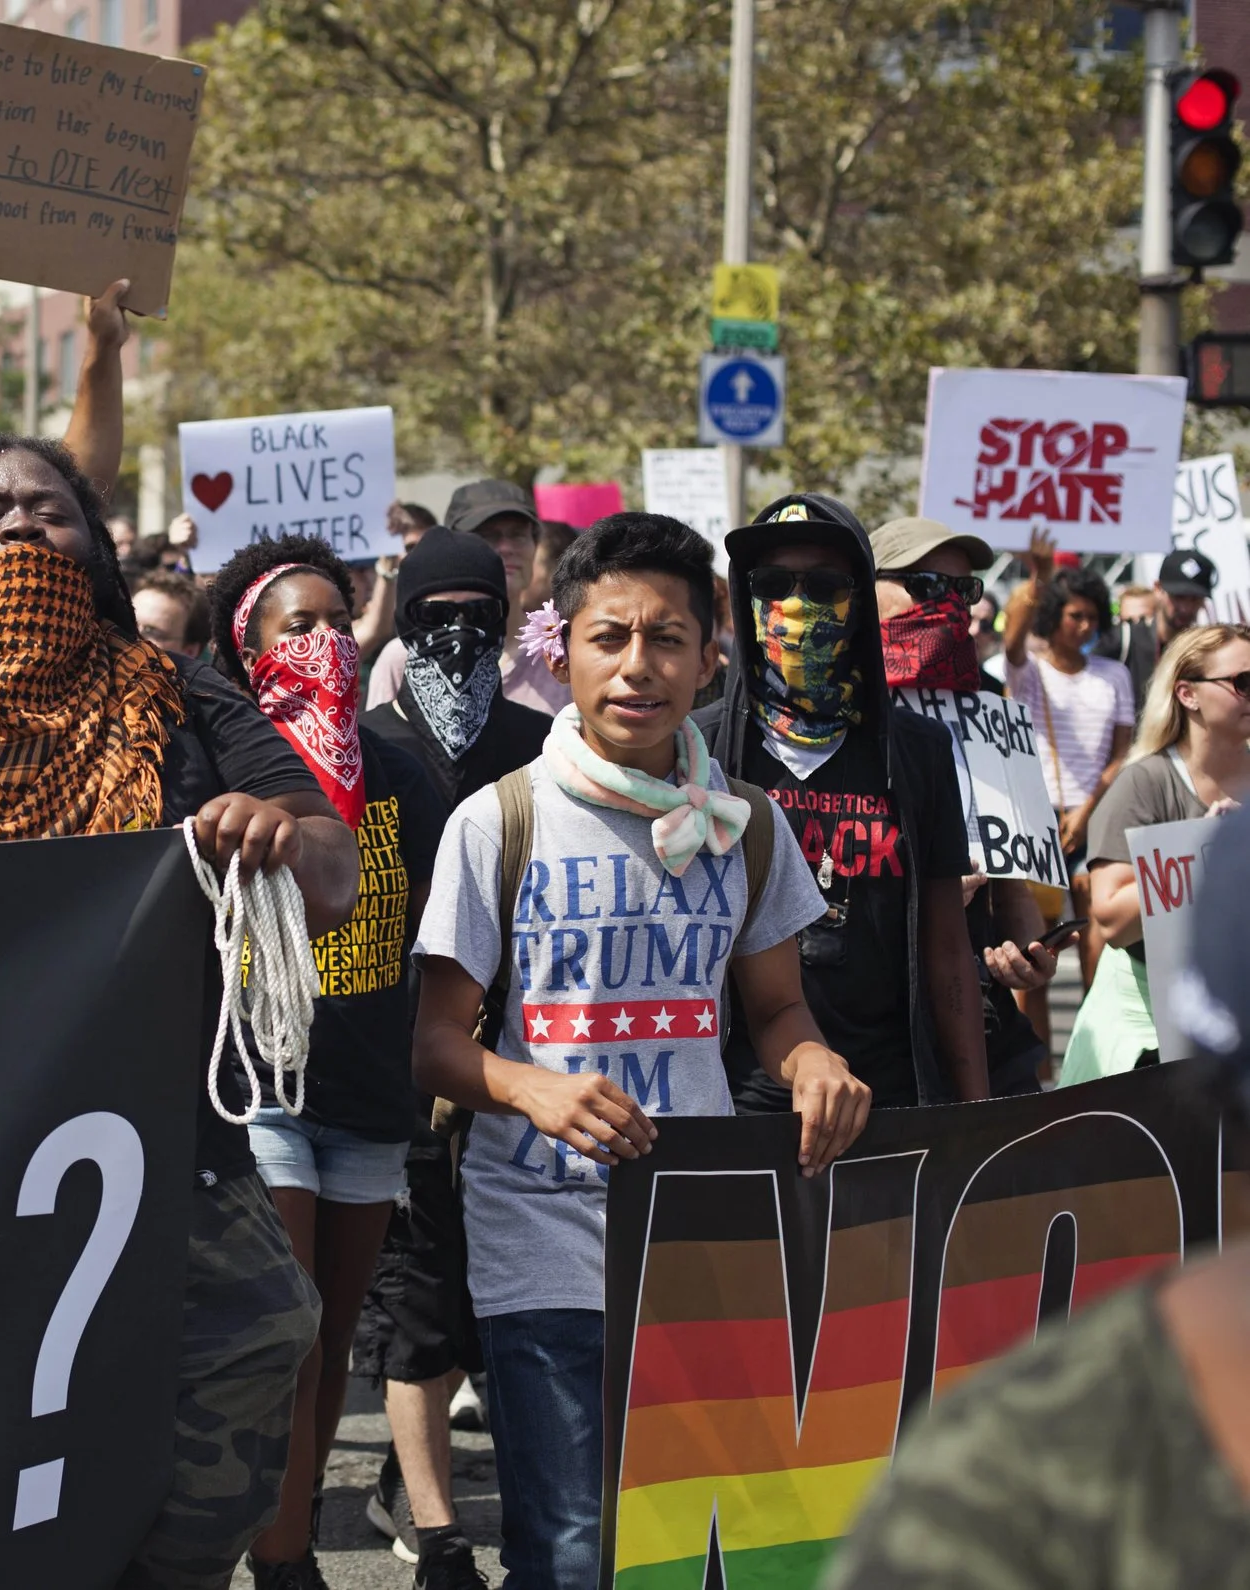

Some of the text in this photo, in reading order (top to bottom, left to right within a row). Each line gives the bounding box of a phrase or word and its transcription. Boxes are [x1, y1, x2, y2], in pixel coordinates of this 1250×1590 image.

[23, 52, 44, 77] to
[51, 52, 92, 86] bite
[56, 109, 92, 137] Has
[105, 122, 166, 161] begun
[7, 144, 38, 181] to
[50, 148, 101, 189] DIE
[109, 165, 179, 209] Next
[251, 423, 329, 454] BLACK
[977, 416, 1129, 469] STOP
[246, 452, 366, 505] LIVES
[972, 469, 1124, 524] HATE
[953, 690, 1037, 758] Right
[360, 796, 399, 825] TTER
[976, 814, 1069, 888] Bowl
[515, 853, 733, 925] RELAX
[1136, 847, 1196, 917] NOT
[310, 937, 405, 972] VESMATTER
[511, 923, 733, 992] TRUMP
